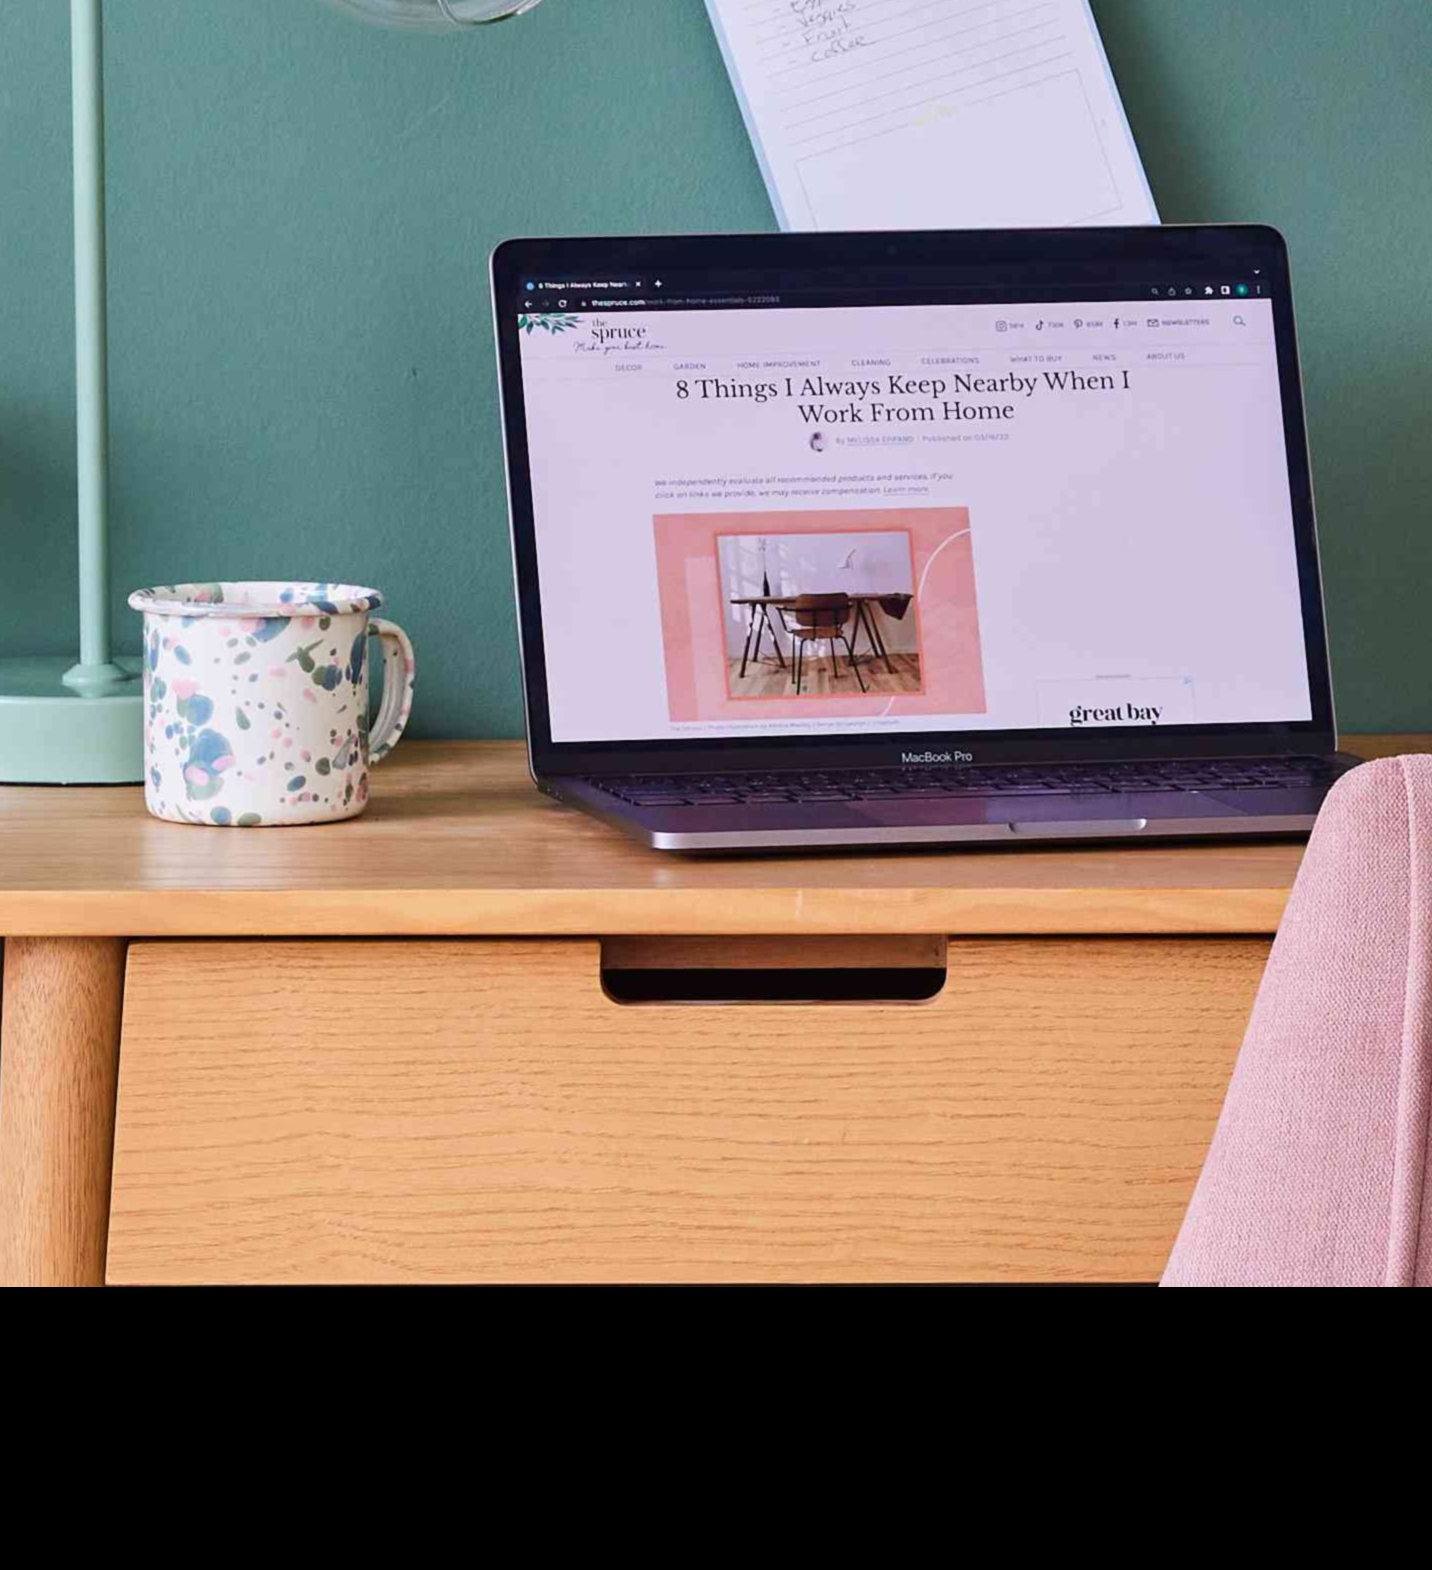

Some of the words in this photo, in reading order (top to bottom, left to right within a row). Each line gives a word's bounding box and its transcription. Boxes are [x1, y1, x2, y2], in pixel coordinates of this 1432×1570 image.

[592, 318, 607, 327] the
[591, 327, 646, 343] spruce
[921, 357, 980, 365] CELEBRATIONS
[1093, 353, 1116, 361] NEWS
[673, 362, 706, 371] GARDEN
[737, 361, 760, 369] HOME
[851, 359, 892, 367] CLEANING
[676, 380, 690, 399] 8
[695, 378, 778, 403] Things
[784, 377, 793, 397] I
[800, 377, 881, 400] Always
[888, 375, 946, 398] Keep
[954, 372, 1038, 397] Nearby
[1043, 370, 1114, 391] When
[1122, 370, 1130, 389] I
[797, 403, 864, 423] Work
[871, 403, 935, 422] From
[942, 401, 1015, 421] Home
[1068, 705, 1123, 727] great
[1126, 703, 1163, 725] bay
[901, 752, 952, 763] MacBook
[954, 751, 973, 762] Pro
